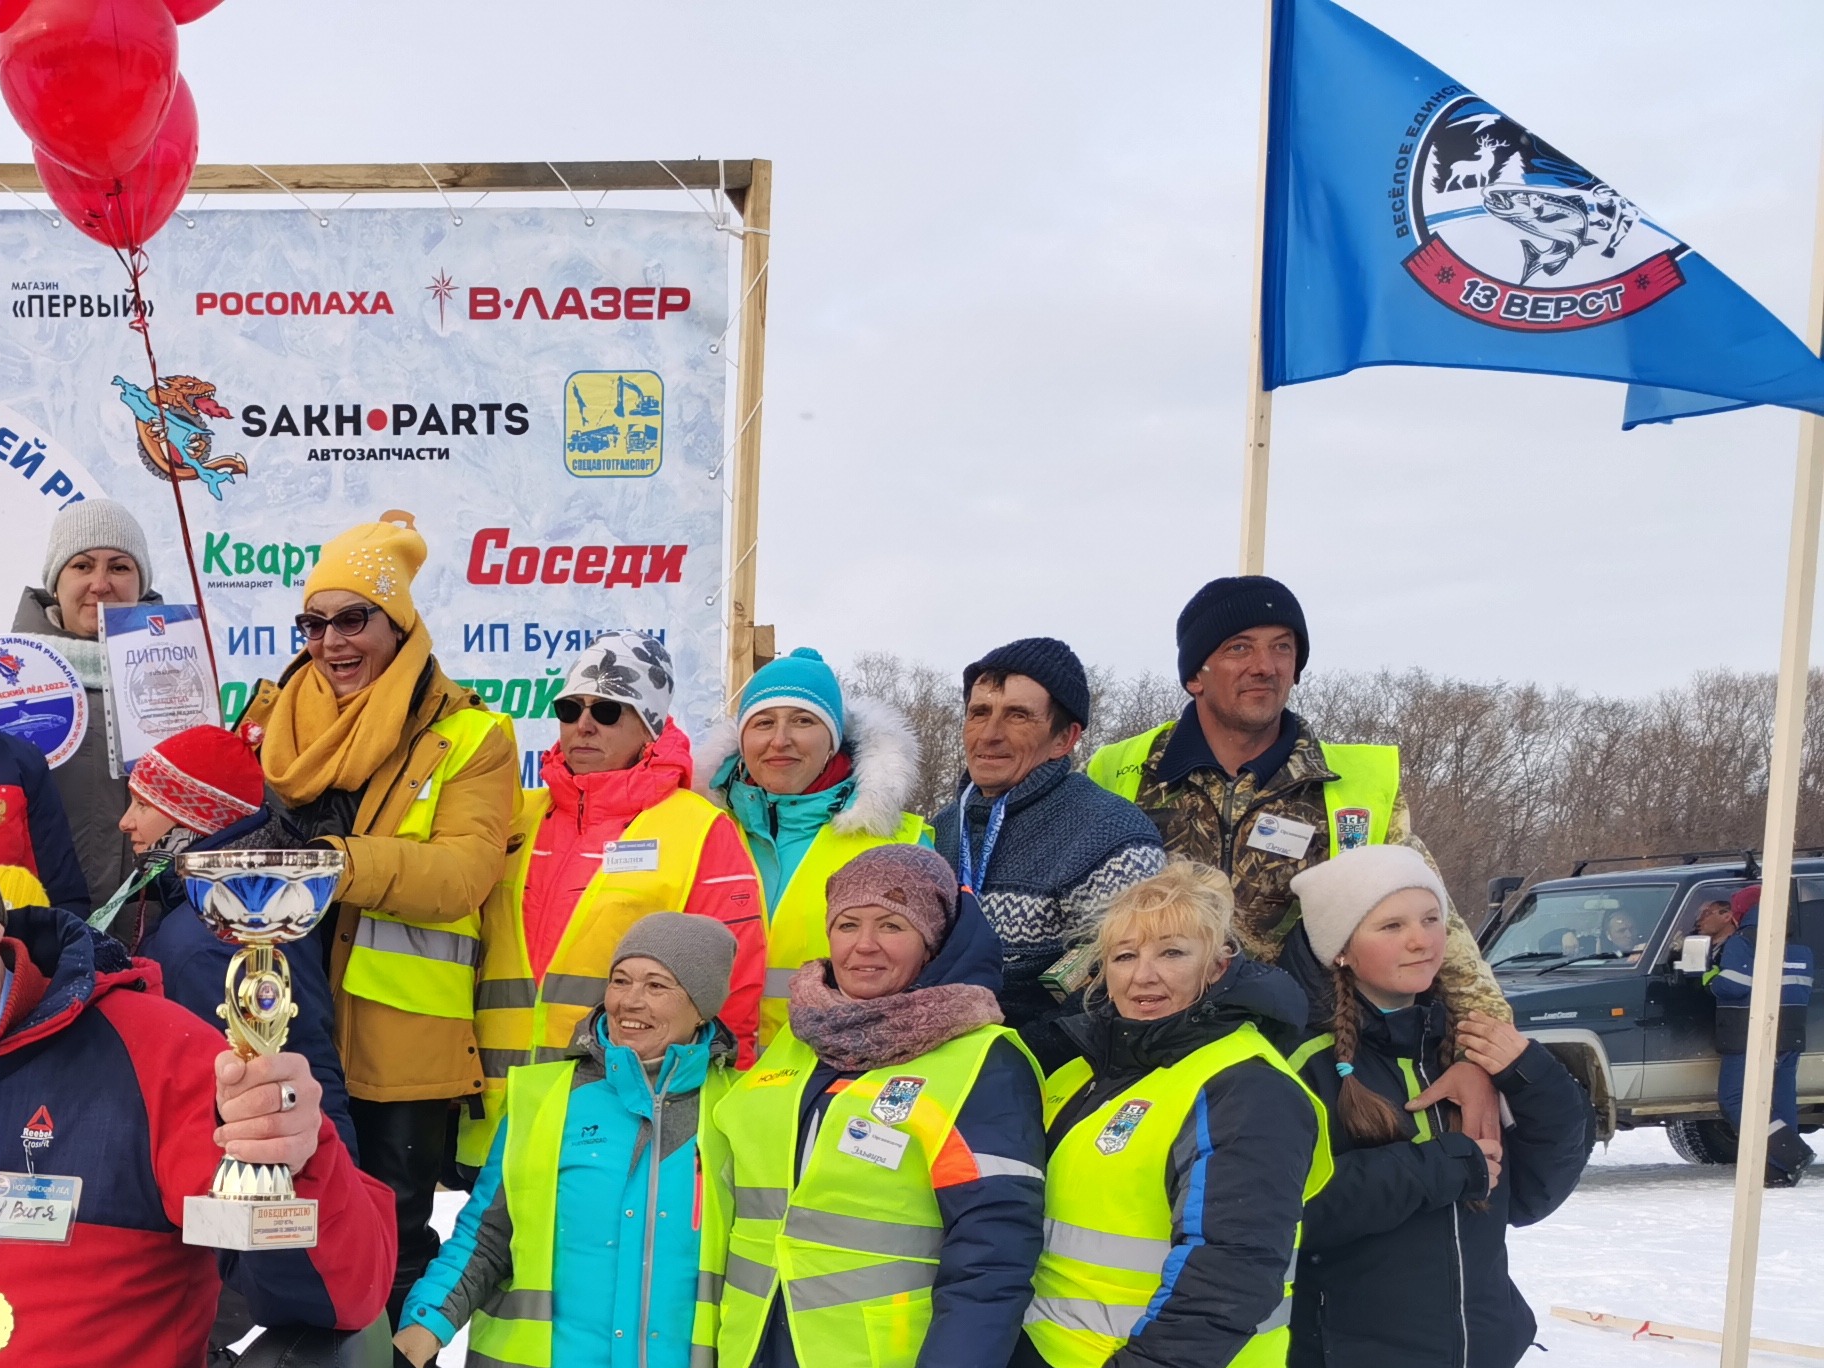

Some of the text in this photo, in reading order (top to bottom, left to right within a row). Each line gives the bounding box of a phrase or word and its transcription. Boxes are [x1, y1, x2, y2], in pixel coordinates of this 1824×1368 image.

[11, 282, 60, 292] МАГАЗИН
[1461, 279, 1625, 321] 13 ВЕРСТ
[12, 288, 154, 318] «ПЕРВЫЙ»
[195, 290, 394, 316] РОСОМАХА
[307, 448, 451, 464] АВТОЗАПЧАСТИ
[572, 459, 655, 472] СПЕЦАВТОТРАНСПОРТ
[466, 527, 688, 588] Соседи
[207, 580, 273, 589] минимаркет
[228, 626, 275, 656] ИП
[463, 623, 509, 653] ИП
[0, 637, 43, 652] ЗИМНЕЙ
[42, 648, 79, 690] РЫБАЛКЕ
[125, 646, 198, 666] ДИПЛОМ
[257, 1207, 311, 1219] ПОБЕДИТЕЛЮ
